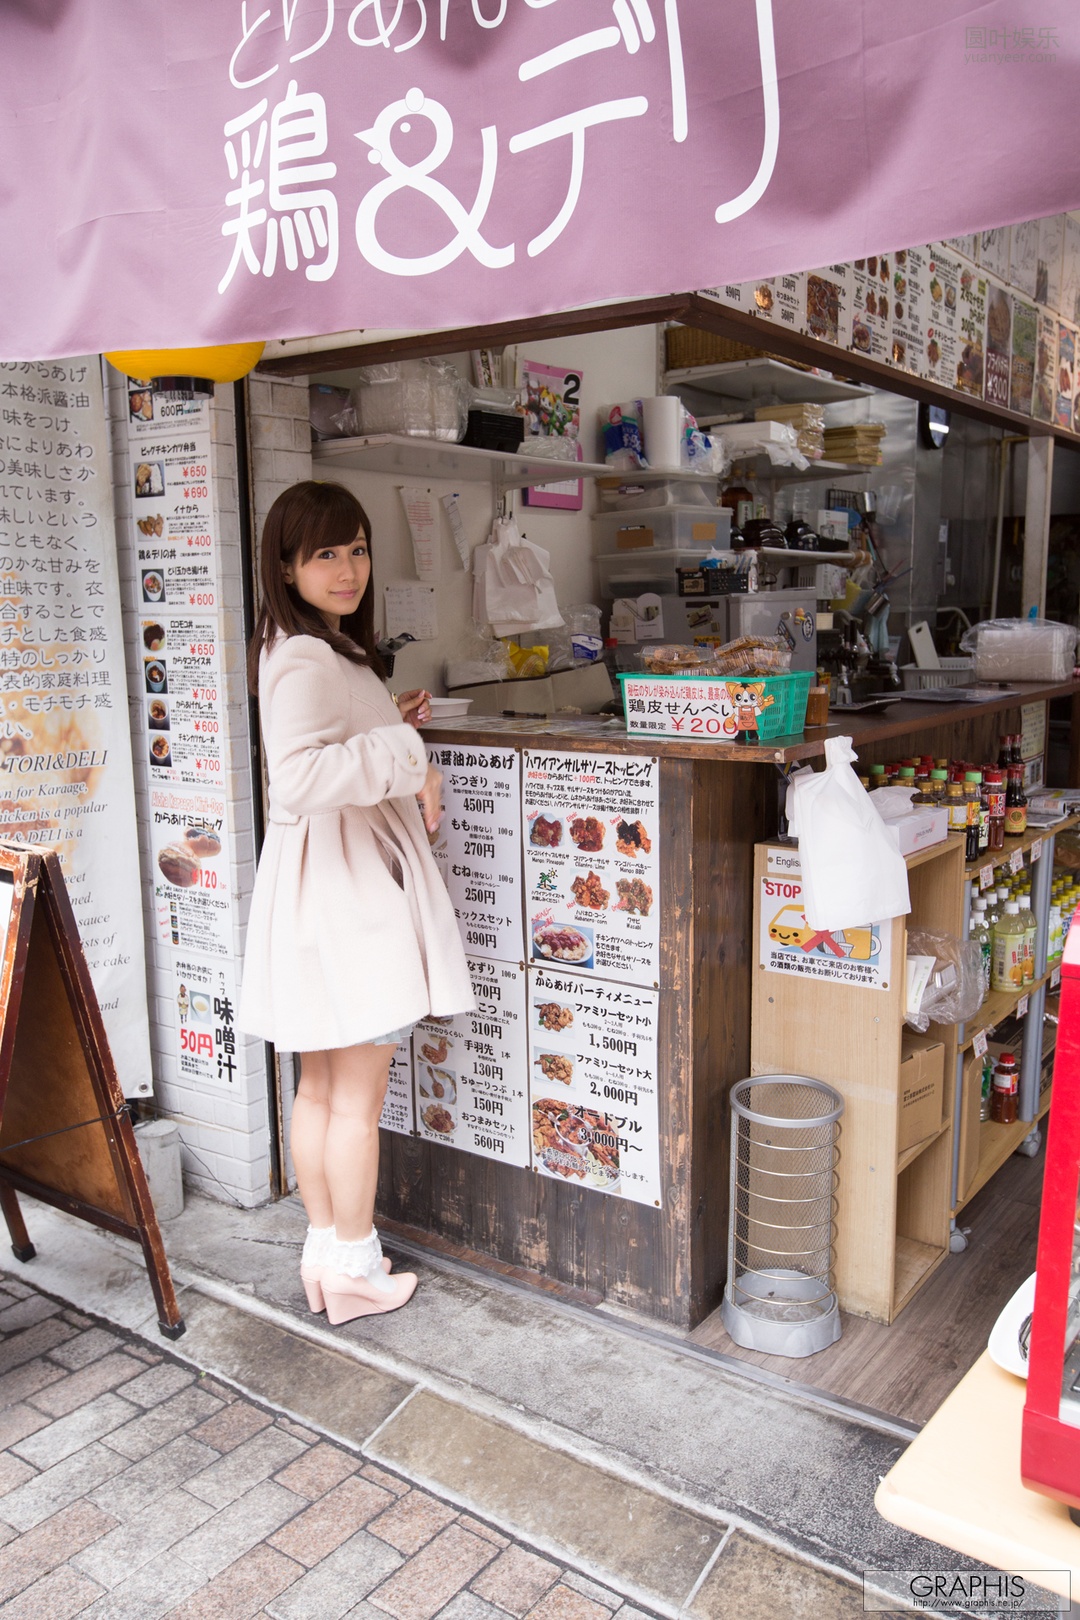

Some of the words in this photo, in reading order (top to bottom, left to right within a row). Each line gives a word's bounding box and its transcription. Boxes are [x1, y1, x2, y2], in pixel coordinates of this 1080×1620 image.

[2, 381, 90, 409] 本格派醤油
[563, 373, 581, 405] 2
[160, 404, 184, 418] 600円
[182, 465, 207, 478] ¥650
[184, 486, 208, 499] ¥690
[187, 535, 212, 547] ¥400
[138, 548, 177, 561] 鶏&デリの丼
[85, 581, 104, 597] 衣
[189, 593, 215, 606] ¥600
[0, 602, 104, 620] 合することで
[189, 643, 215, 656] ¥650
[192, 687, 218, 701] ¥700
[194, 719, 219, 733] ¥600
[629, 720, 666, 730] 数量限定
[7, 749, 108, 774] TORI&DELI
[195, 758, 221, 772] ¥700
[525, 755, 653, 778] ハワイアンサルサソーストッピング
[449, 774, 488, 789] ぶつぎり
[15, 785, 34, 802] for
[38, 781, 88, 797] Karaage,
[41, 810, 50, 820] is
[54, 808, 61, 818] a
[64, 801, 108, 820] popular
[463, 797, 494, 815] 450円
[154, 811, 224, 831] からあげミニドッグ
[28, 829, 62, 843] DELI
[65, 828, 74, 839] is
[76, 828, 83, 838] a
[464, 841, 495, 859] 270円
[776, 856, 802, 869] Englis
[191, 867, 218, 889] ¥120
[464, 887, 496, 906] 250円
[765, 881, 802, 899] STOP
[78, 914, 111, 928] sauce
[454, 908, 513, 927] ミックスセット
[103, 932, 118, 947] of
[466, 930, 497, 949] 490円
[103, 954, 131, 969] cake
[770, 951, 880, 976] 当店では、お車でご来店のお客様へ
[770, 961, 878, 985] の酒類の販売をお断りしております。
[574, 1002, 652, 1027] ファミリーセット小
[213, 996, 237, 1083] 味噌汁
[471, 1020, 503, 1040] 310円
[180, 1028, 214, 1059] 50円
[463, 1039, 495, 1057] 手羽先
[472, 1061, 504, 1081] 130円
[576, 1053, 653, 1080] ファミリーセット大
[460, 1075, 507, 1094] ちゅーりっぷ
[473, 1096, 503, 1117] 150円
[461, 1112, 516, 1134] おつまみセット
[574, 1105, 643, 1134] オードブル
[474, 1133, 504, 1155] 560円
